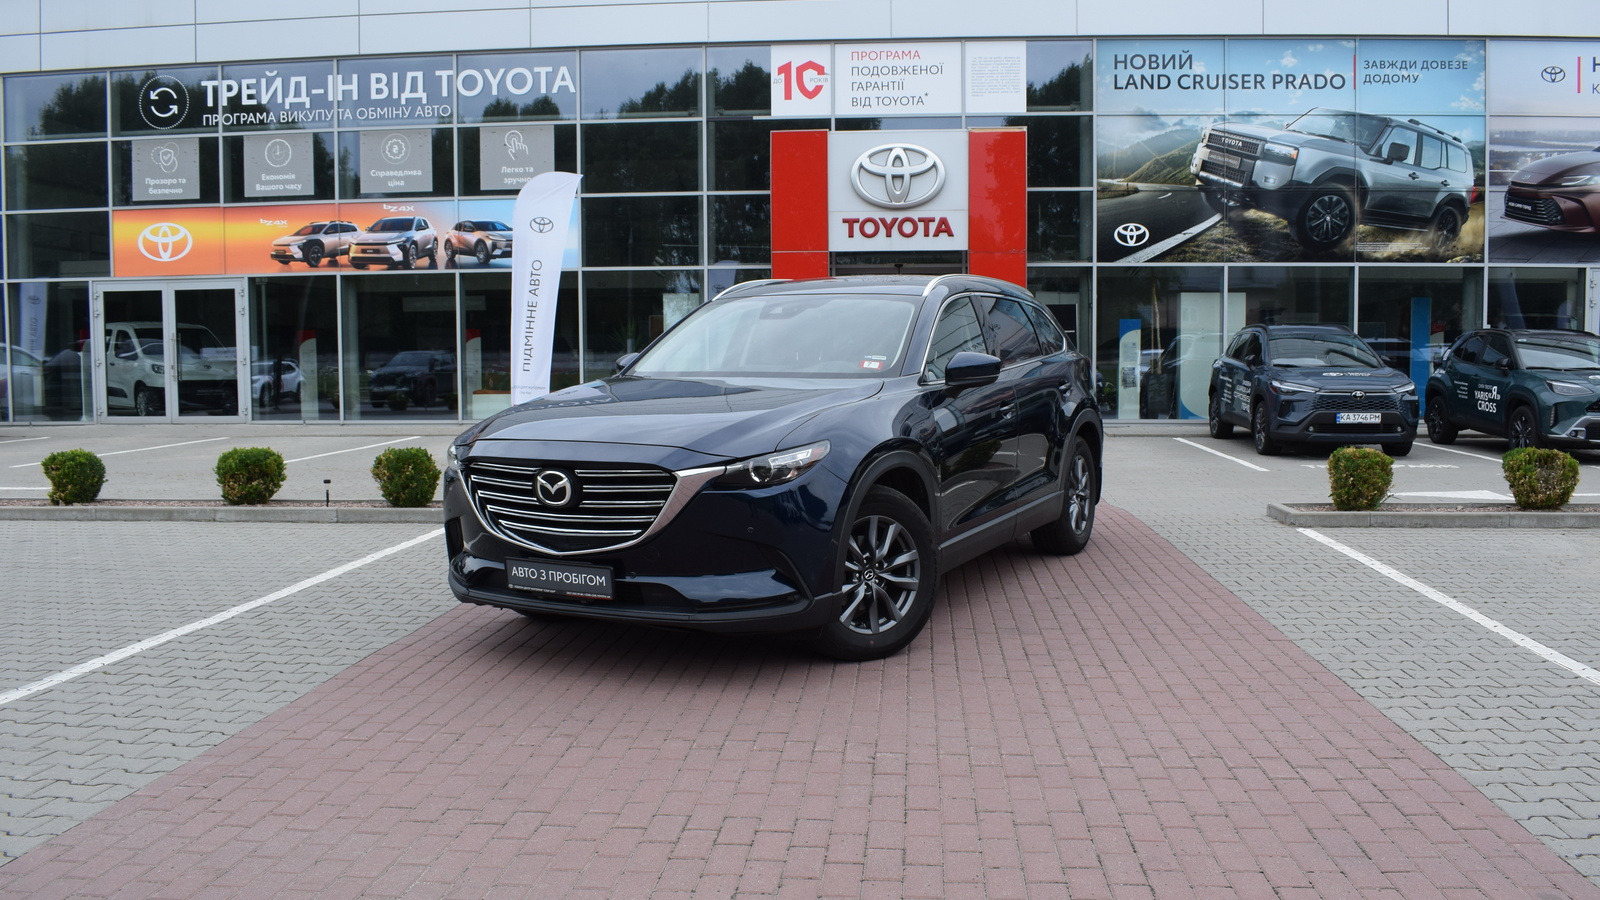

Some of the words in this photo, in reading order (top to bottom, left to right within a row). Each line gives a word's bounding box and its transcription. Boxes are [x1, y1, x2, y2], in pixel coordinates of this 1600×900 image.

[851, 50, 921, 61] ПРОГРАМА
[1114, 50, 1193, 70] НОВИЙ
[851, 62, 944, 77] ПОДОВЖЕНОЇ
[1363, 60, 1417, 72] ЗАВЖДИ
[1420, 60, 1468, 72] ДОВЕЗЕ
[851, 79, 905, 92] ГАРАНТІЇ
[1114, 74, 1171, 90] LAND
[1177, 73, 1266, 90] CRUISER
[1272, 73, 1346, 90] PRADO
[1363, 74, 1419, 85] ДОДОМУ
[201, 70, 359, 109] ТРЕЙД-ІН
[370, 71, 427, 105] ВІД
[435, 66, 576, 97] TOYOTA
[851, 96, 872, 109] ВІД
[203, 112, 276, 126] ПРОГРАМА
[280, 109, 334, 124] ВИКУПУ
[337, 109, 353, 120] ТА
[356, 106, 411, 120] ОБМІНУ
[415, 105, 451, 118] АВТО
[1221, 137, 1243, 147] TOYOTA
[370, 169, 422, 178] Справедлива
[501, 166, 524, 174] Легко
[145, 177, 177, 186] Прозоро
[261, 173, 296, 181] Економія
[387, 179, 405, 187] ціна
[148, 187, 183, 195] безпечно
[255, 183, 283, 191] Вашого
[842, 216, 954, 238] TOYOTA
[528, 259, 543, 297] АВТО
[522, 300, 538, 372] ПІДМІННЕ
[1474, 390, 1488, 401] YARIS
[1477, 400, 1497, 413] CROSS
[511, 566, 538, 580] АВТО
[540, 569, 547, 580] З
[548, 570, 606, 586] ПРОБІГОМ
